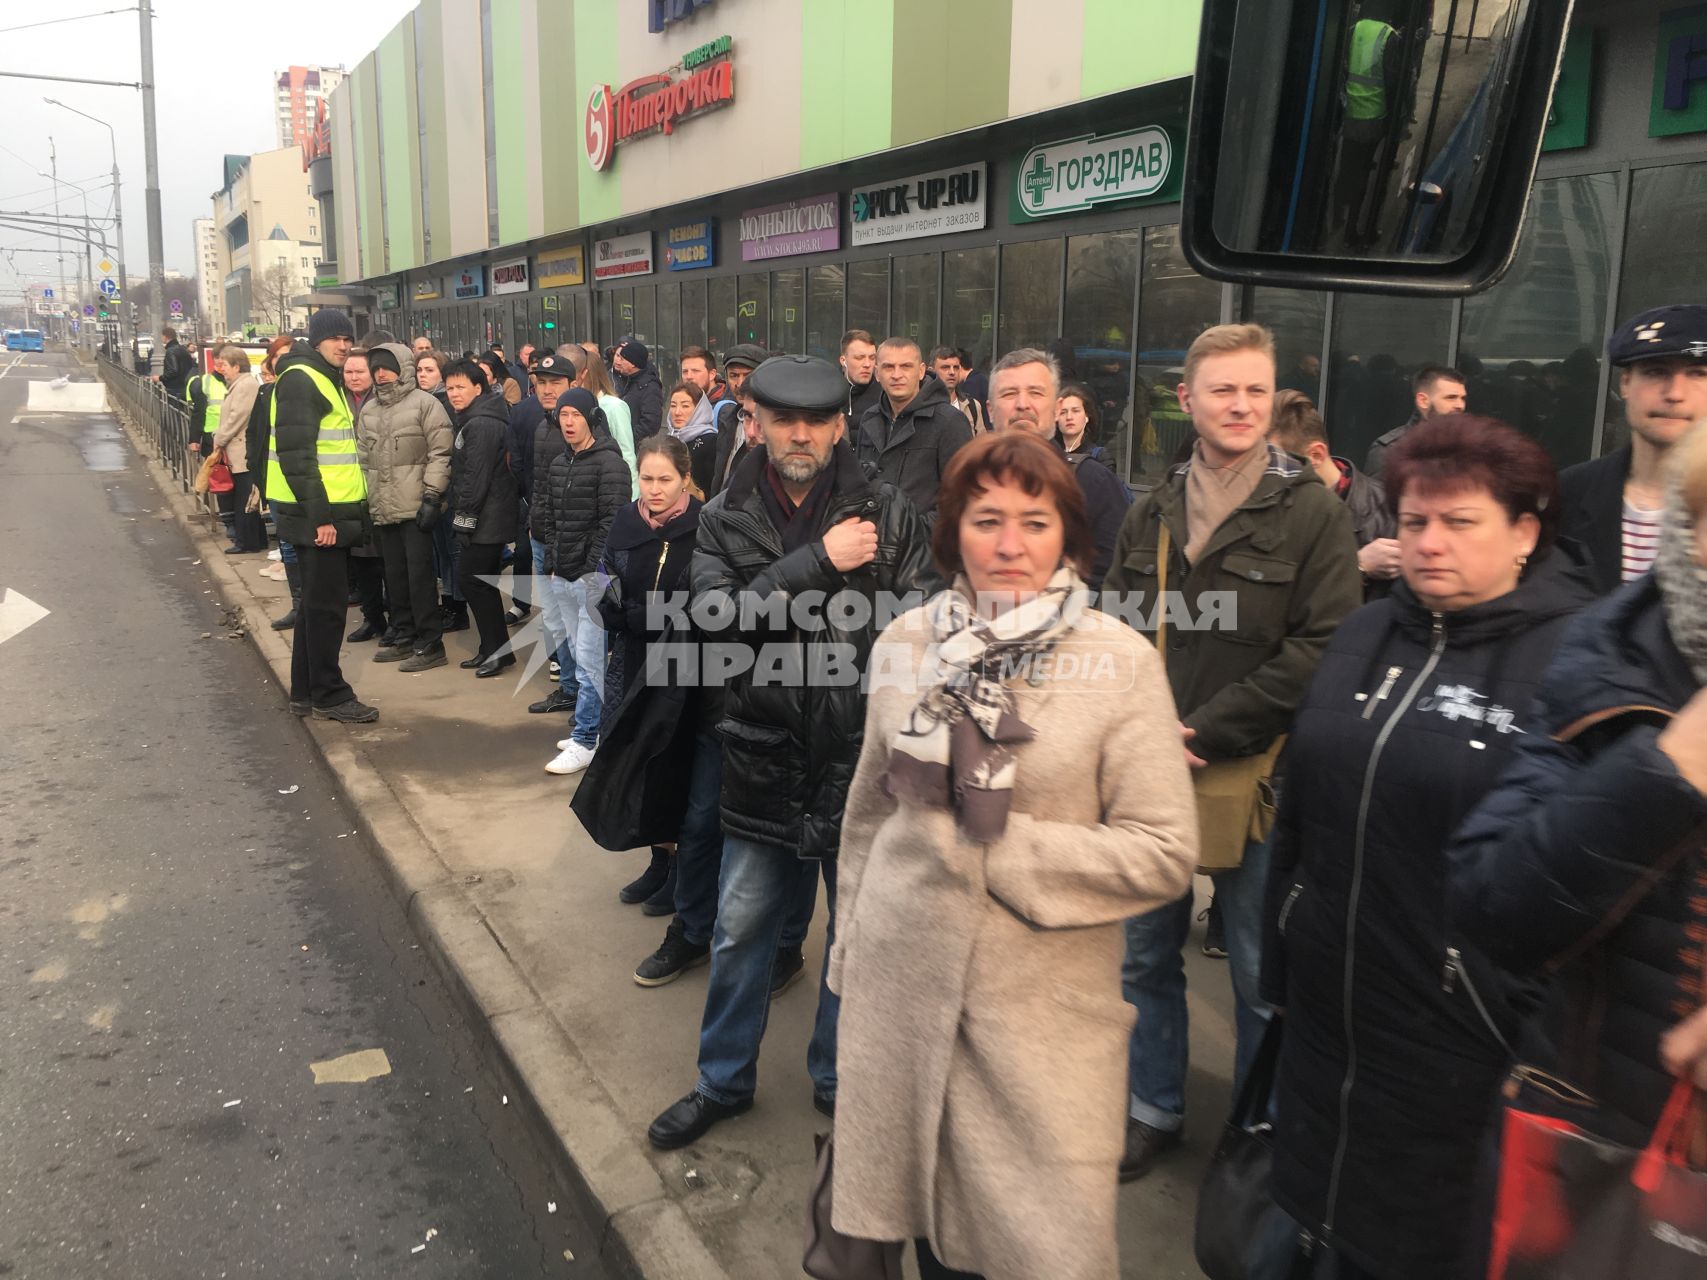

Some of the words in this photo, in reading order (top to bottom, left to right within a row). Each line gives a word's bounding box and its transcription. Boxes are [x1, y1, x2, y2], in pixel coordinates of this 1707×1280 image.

[682, 35, 732, 70] УНИВЕРСАМ
[612, 61, 732, 139] Пятерочка
[1027, 175, 1051, 187] Аптеки
[1056, 142, 1163, 193] ГОРЗДРАВ
[869, 170, 979, 220] PICK-UP.RU
[669, 222, 706, 243] РЕМОНТ
[739, 201, 834, 244] МОДНЫЙСТОК
[855, 228, 874, 241] пункт
[877, 224, 903, 238] выдачи
[905, 217, 942, 232] интернет
[945, 211, 980, 227] заказов
